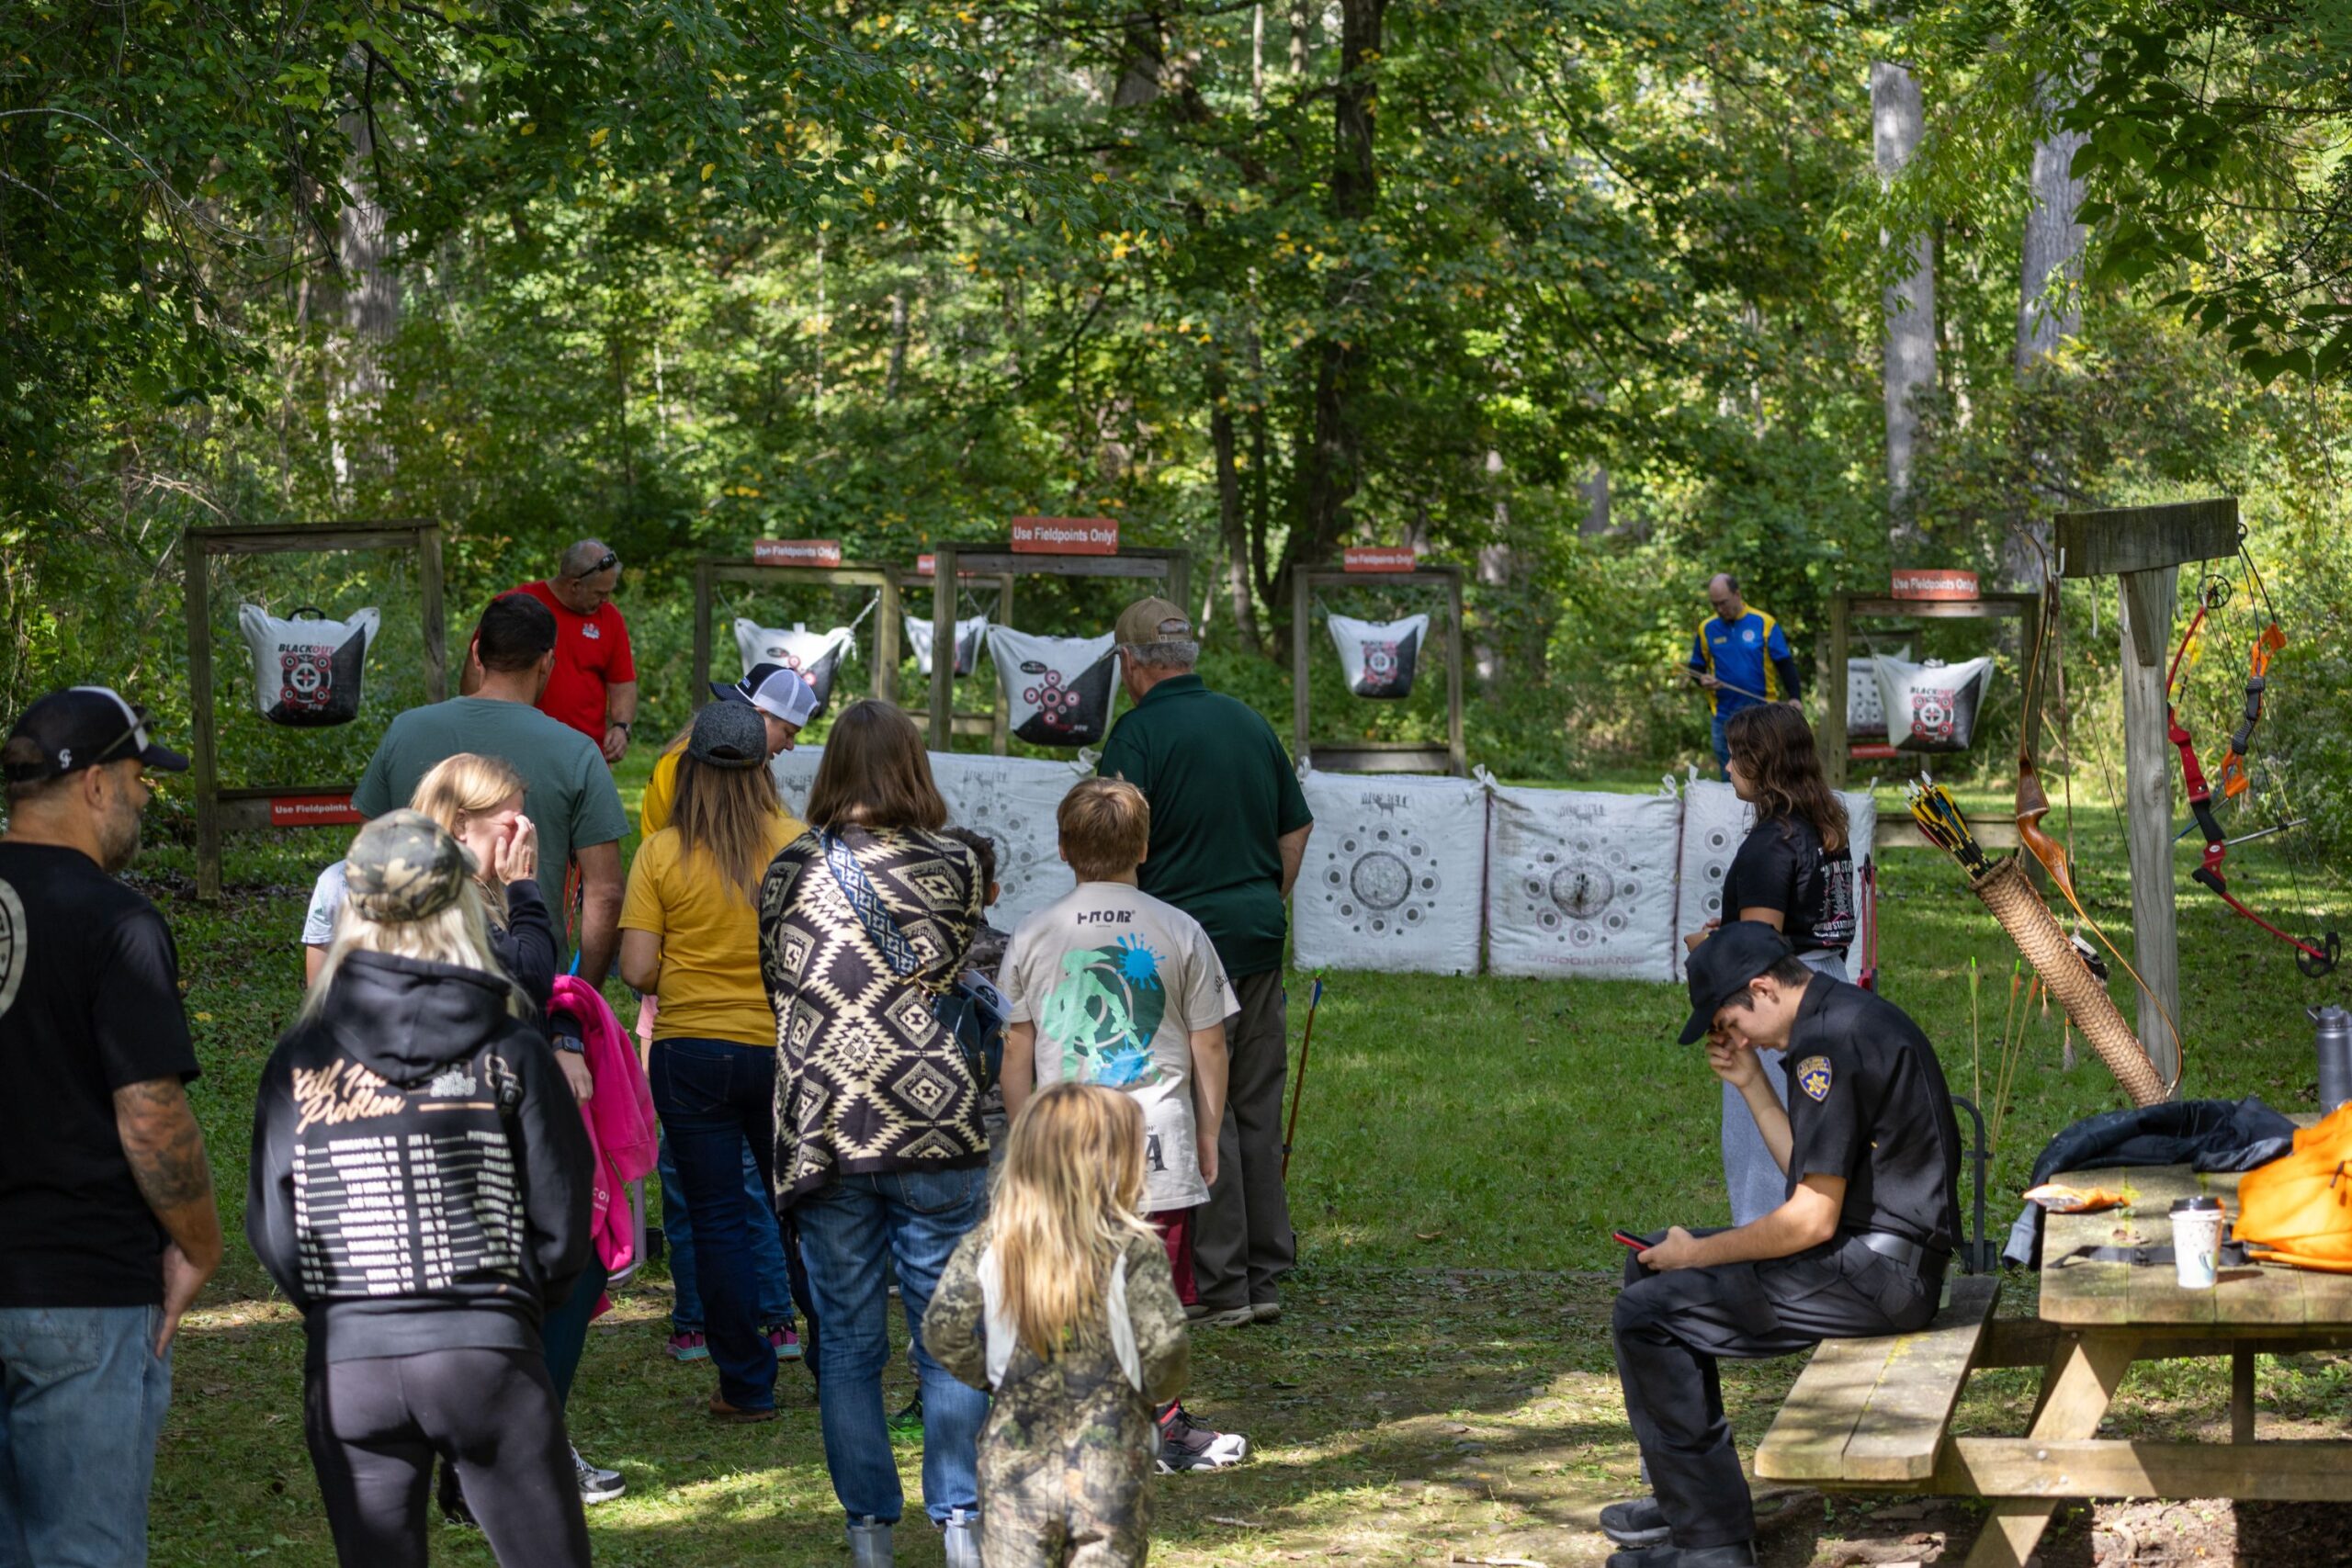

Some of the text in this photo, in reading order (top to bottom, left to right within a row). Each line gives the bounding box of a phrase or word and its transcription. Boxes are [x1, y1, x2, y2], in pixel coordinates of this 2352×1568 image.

[1013, 526, 1116, 546] Use Fieldpoints Only!
[1893, 578, 1978, 592] Use Fieldpoints Only!
[277, 644, 335, 654] BLACKOUT
[296, 805, 348, 814] Fieldpoints
[296, 1088, 407, 1134] Problem
